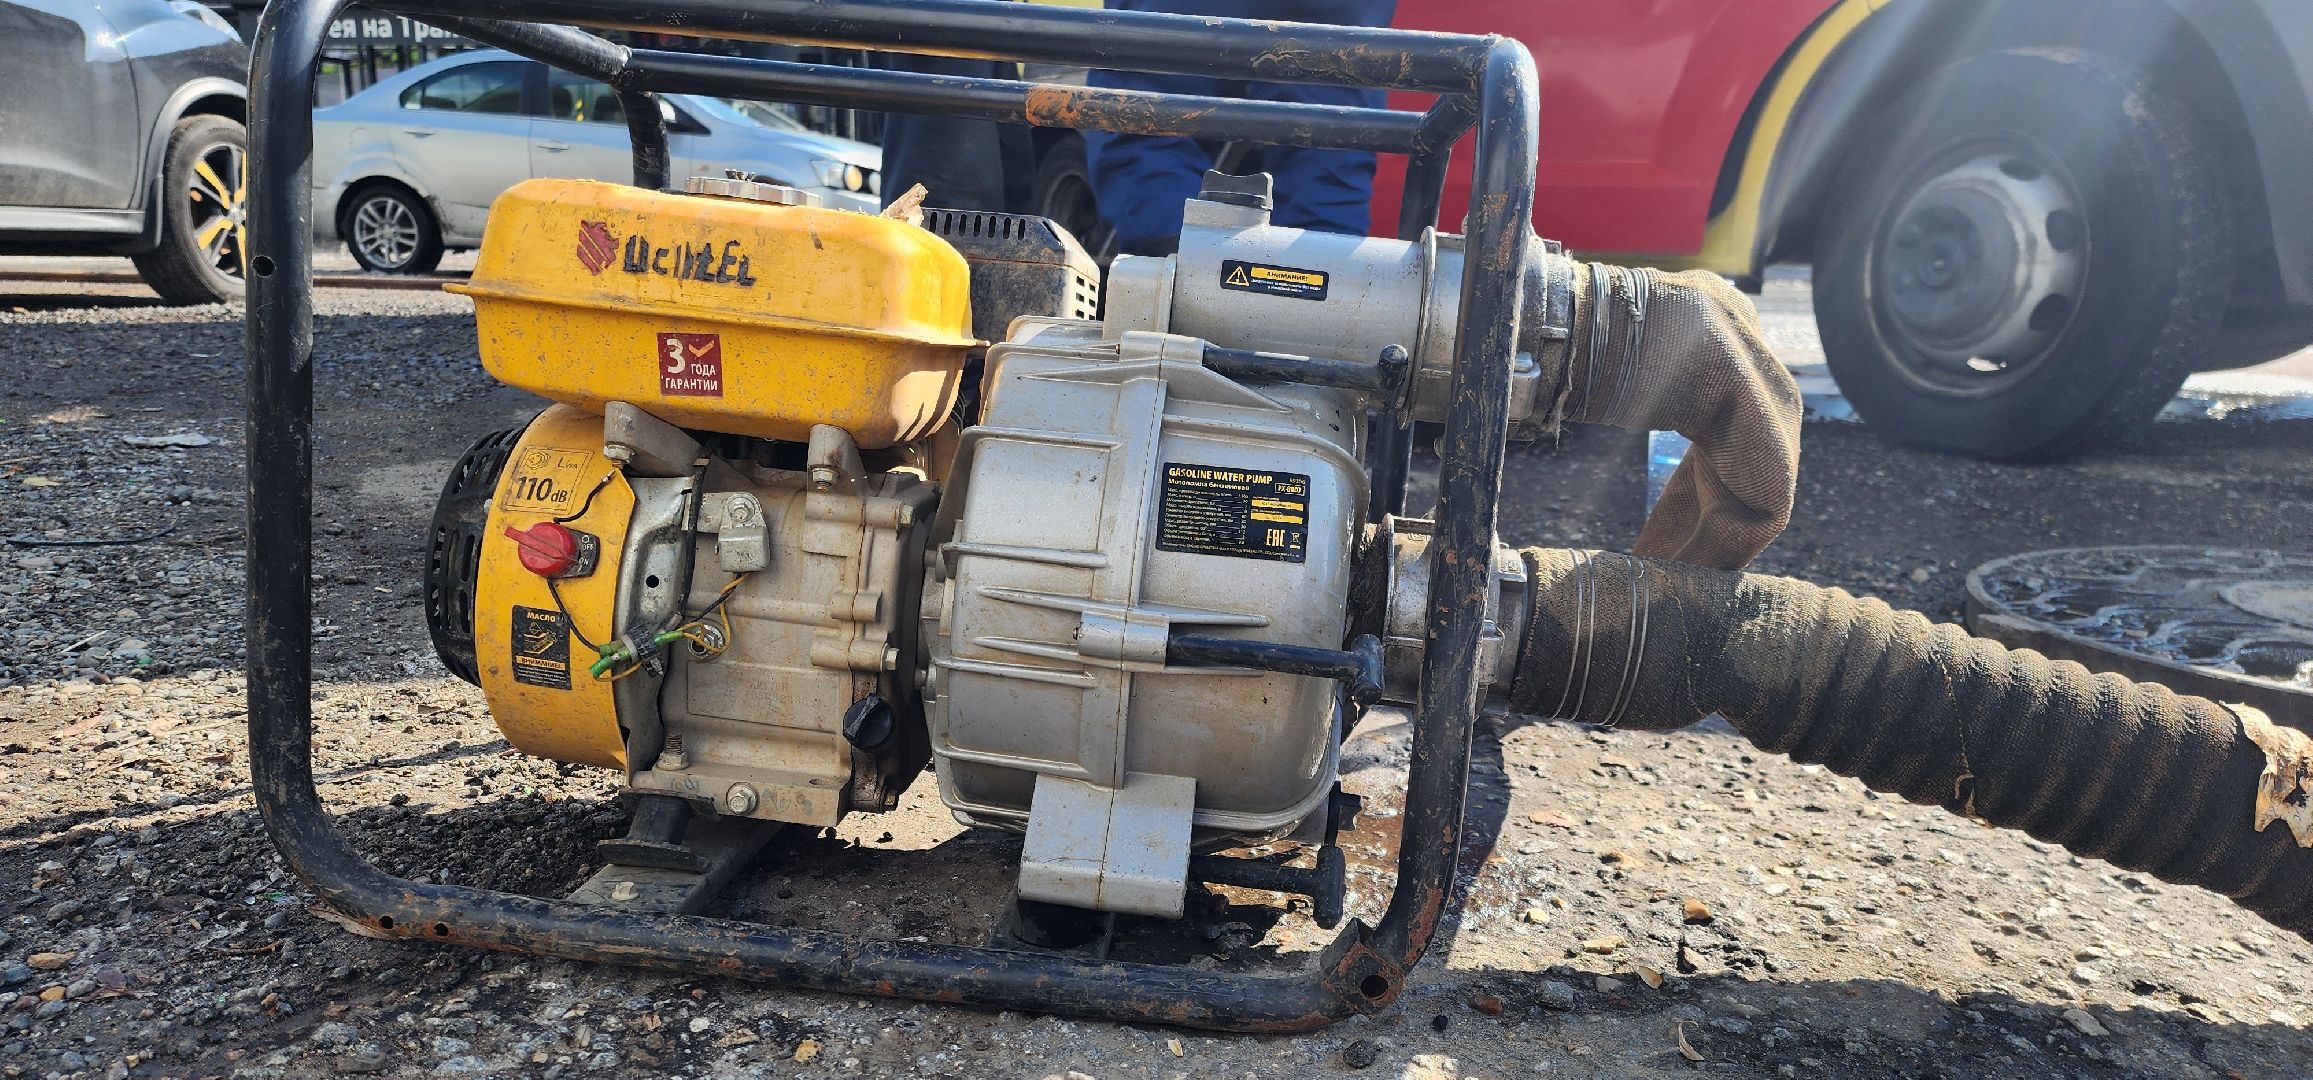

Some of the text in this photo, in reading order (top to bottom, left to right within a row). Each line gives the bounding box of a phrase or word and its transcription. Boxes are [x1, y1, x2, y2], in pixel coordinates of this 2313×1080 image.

[328, 15, 460, 43] ея на Тра
[666, 338, 716, 378] 3 ГОДА
[665, 377, 718, 391] ГАРАНТИИ
[1168, 467, 1273, 485] GASOLINE WATER PUMP
[582, 543, 594, 551] OFF
[578, 557, 590, 566] ON
[526, 611, 556, 623] МАСЛО
